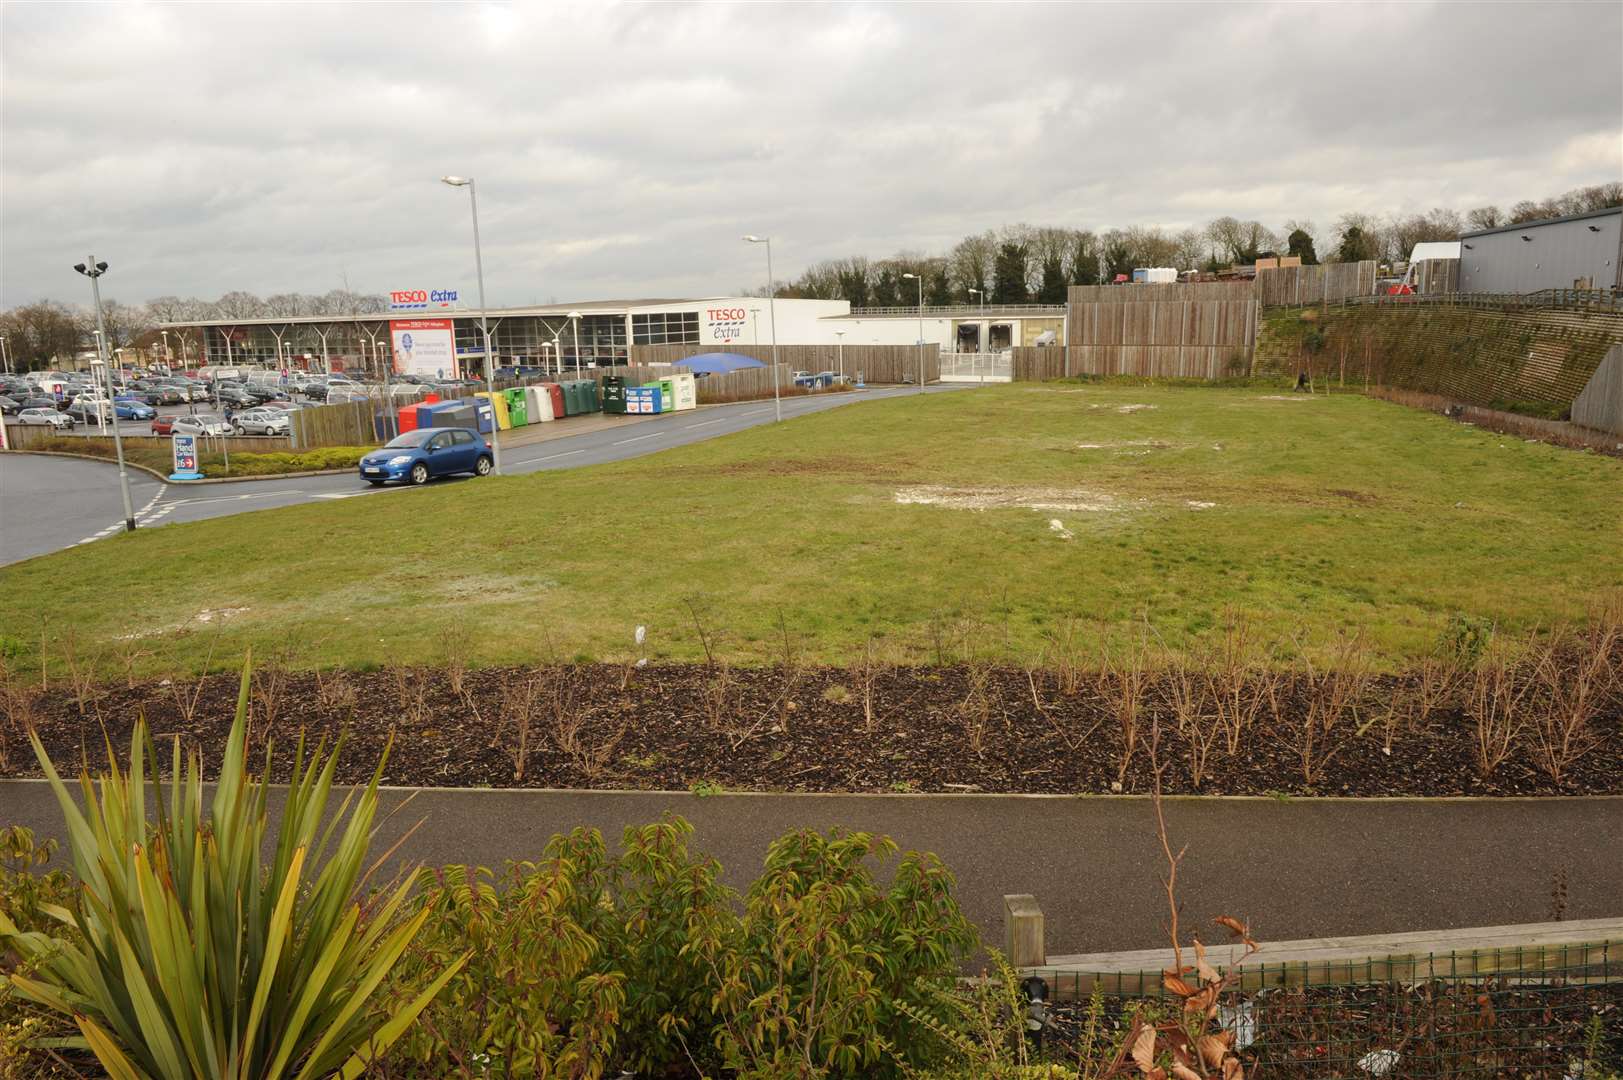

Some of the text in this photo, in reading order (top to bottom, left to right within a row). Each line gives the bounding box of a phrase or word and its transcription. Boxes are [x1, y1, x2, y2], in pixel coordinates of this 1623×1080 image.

[390, 290, 458, 303] TESCO extra
[707, 309, 746, 321] TESCO
[713, 327, 740, 339] extra
